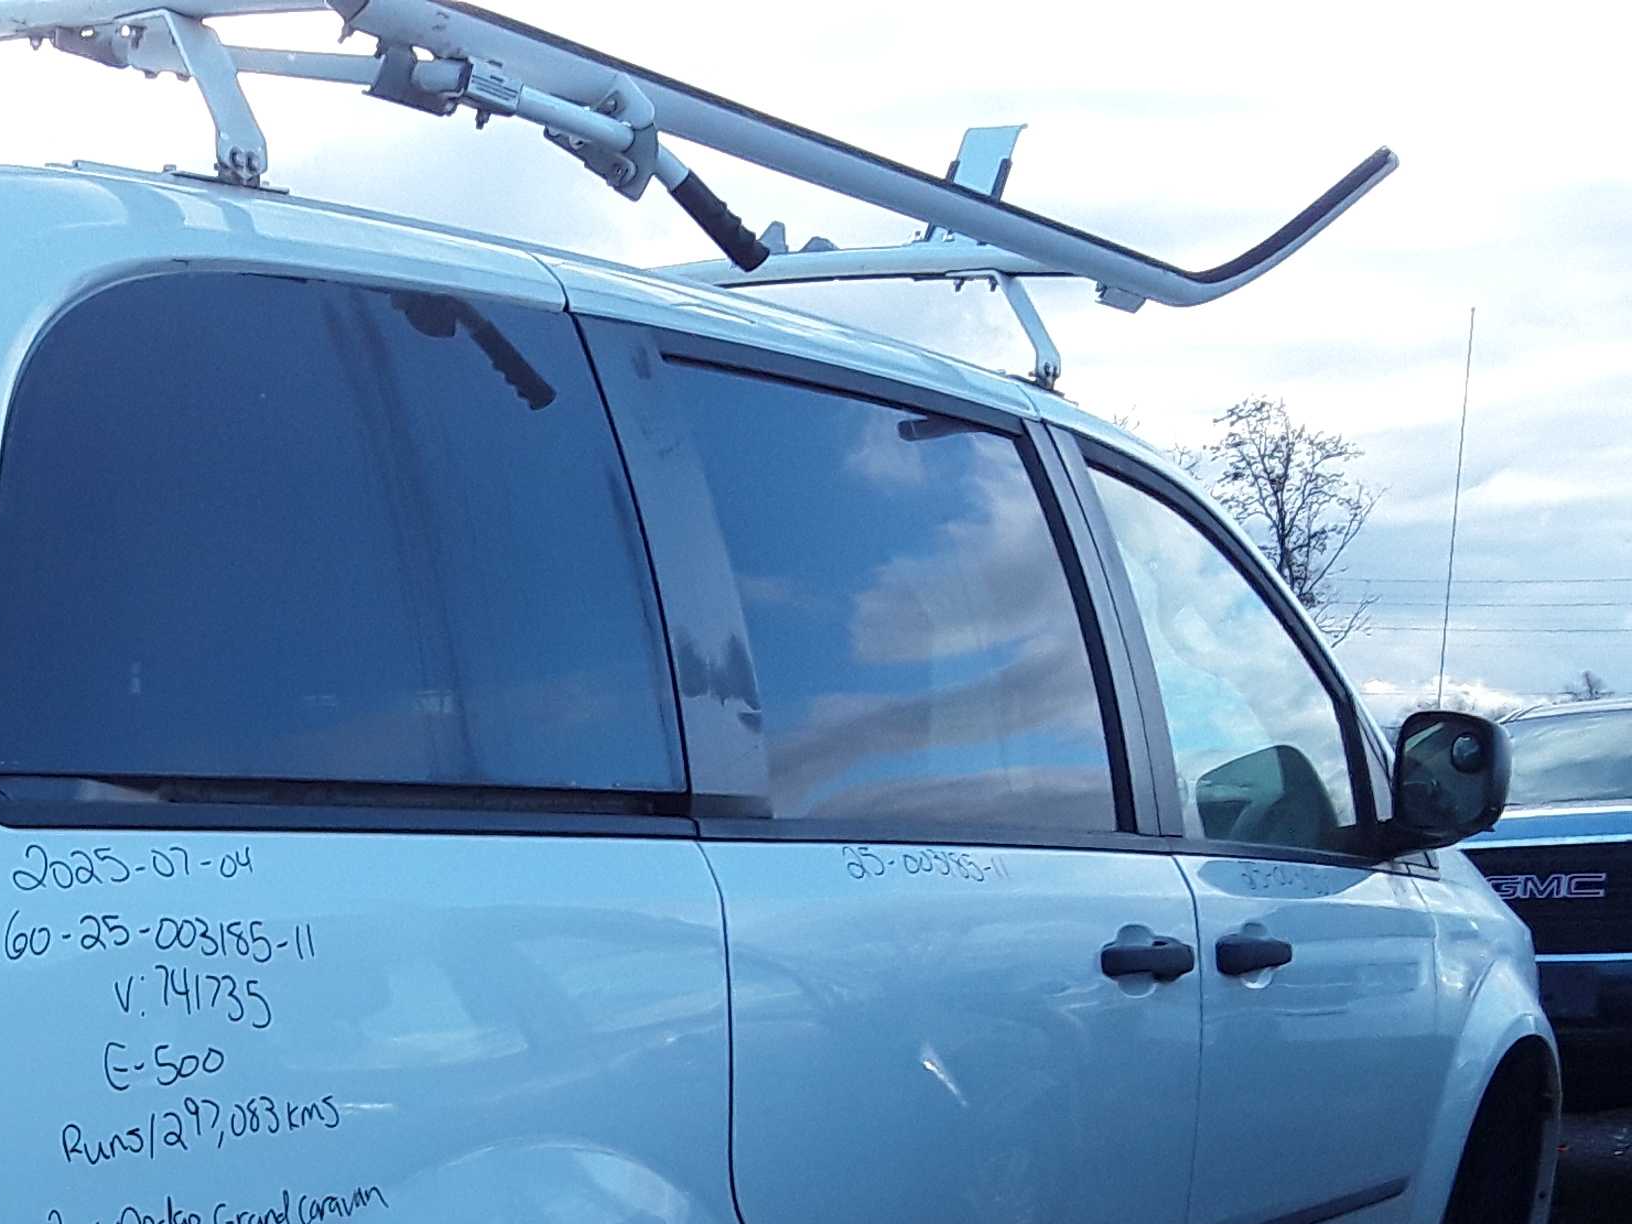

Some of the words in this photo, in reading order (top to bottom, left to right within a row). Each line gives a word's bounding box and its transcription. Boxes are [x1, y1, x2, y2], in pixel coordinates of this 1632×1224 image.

[12, 844, 254, 890] 2025-07-04
[1485, 873, 1607, 900] GMC
[5, 910, 315, 962] 60-25-003185-11
[104, 1041, 225, 1091] E-500
